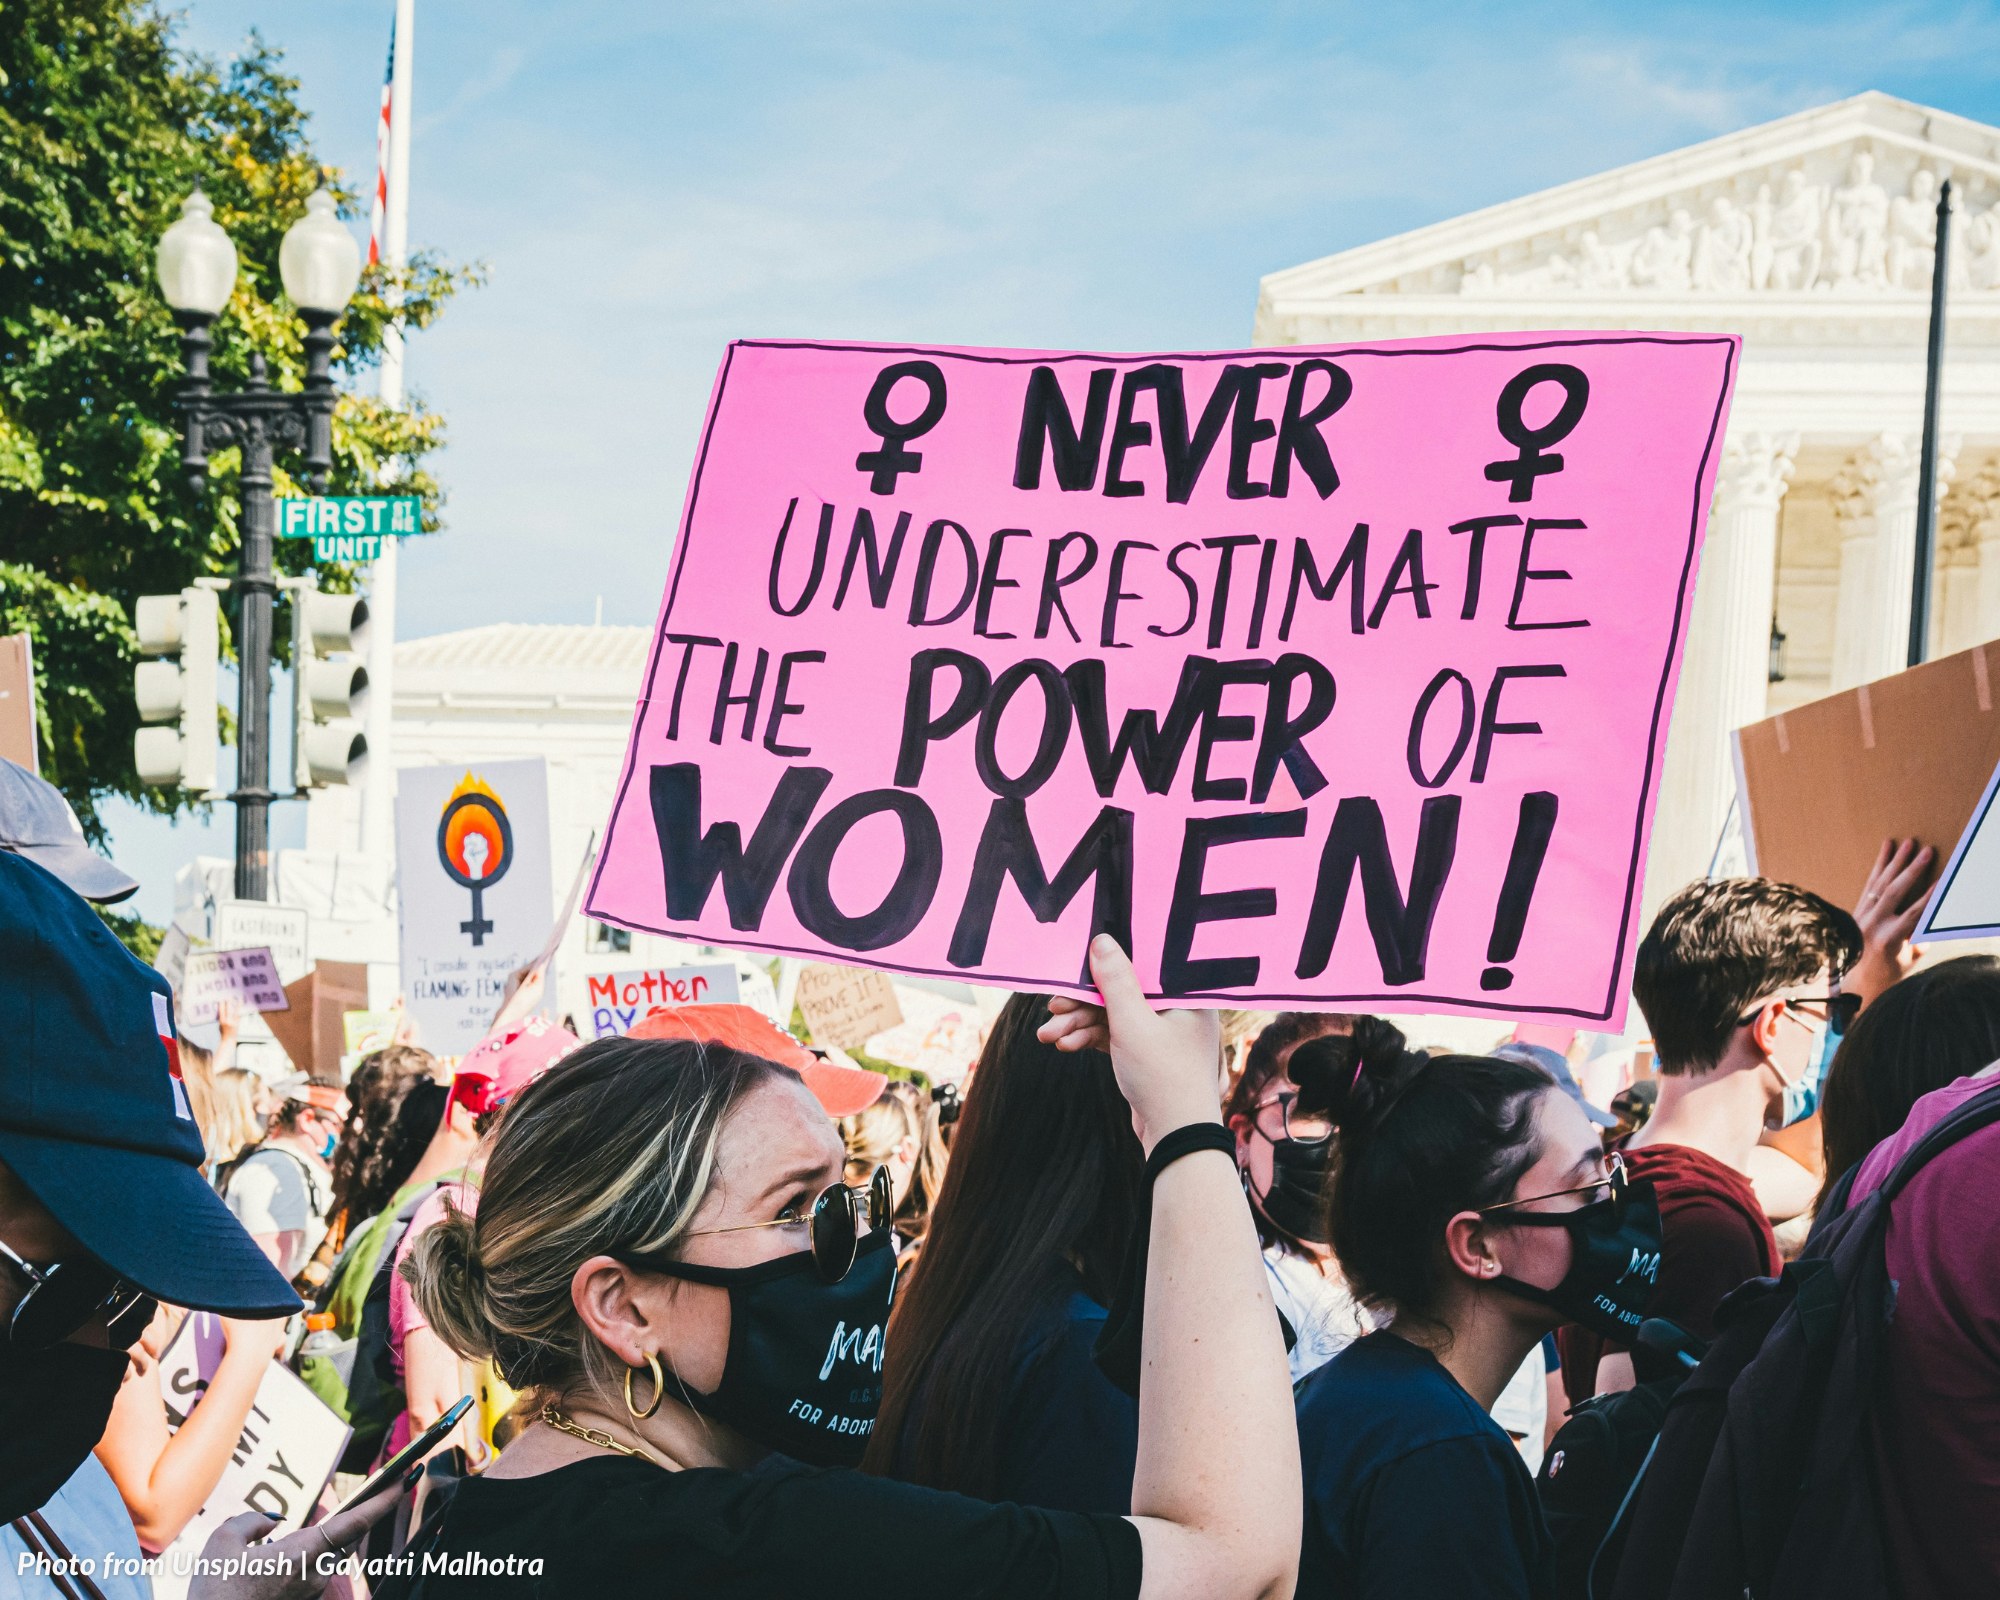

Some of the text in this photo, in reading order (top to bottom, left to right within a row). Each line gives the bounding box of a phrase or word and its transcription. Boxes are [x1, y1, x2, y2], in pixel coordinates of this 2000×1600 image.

[1014, 358, 1352, 505] NEVER
[286, 499, 388, 534] FIRST
[317, 535, 378, 560] UNIT
[768, 497, 1591, 650] UNDERESTIMATE
[665, 633, 1567, 804] THE POWER OF
[649, 761, 1559, 994] WOMEN!
[413, 979, 470, 1000] FLAMING
[588, 970, 709, 1007] Mother
[593, 1008, 636, 1037] BY
[1593, 1294, 1643, 1326] FOR ABOR
[788, 1398, 877, 1435] FOR ABORT
